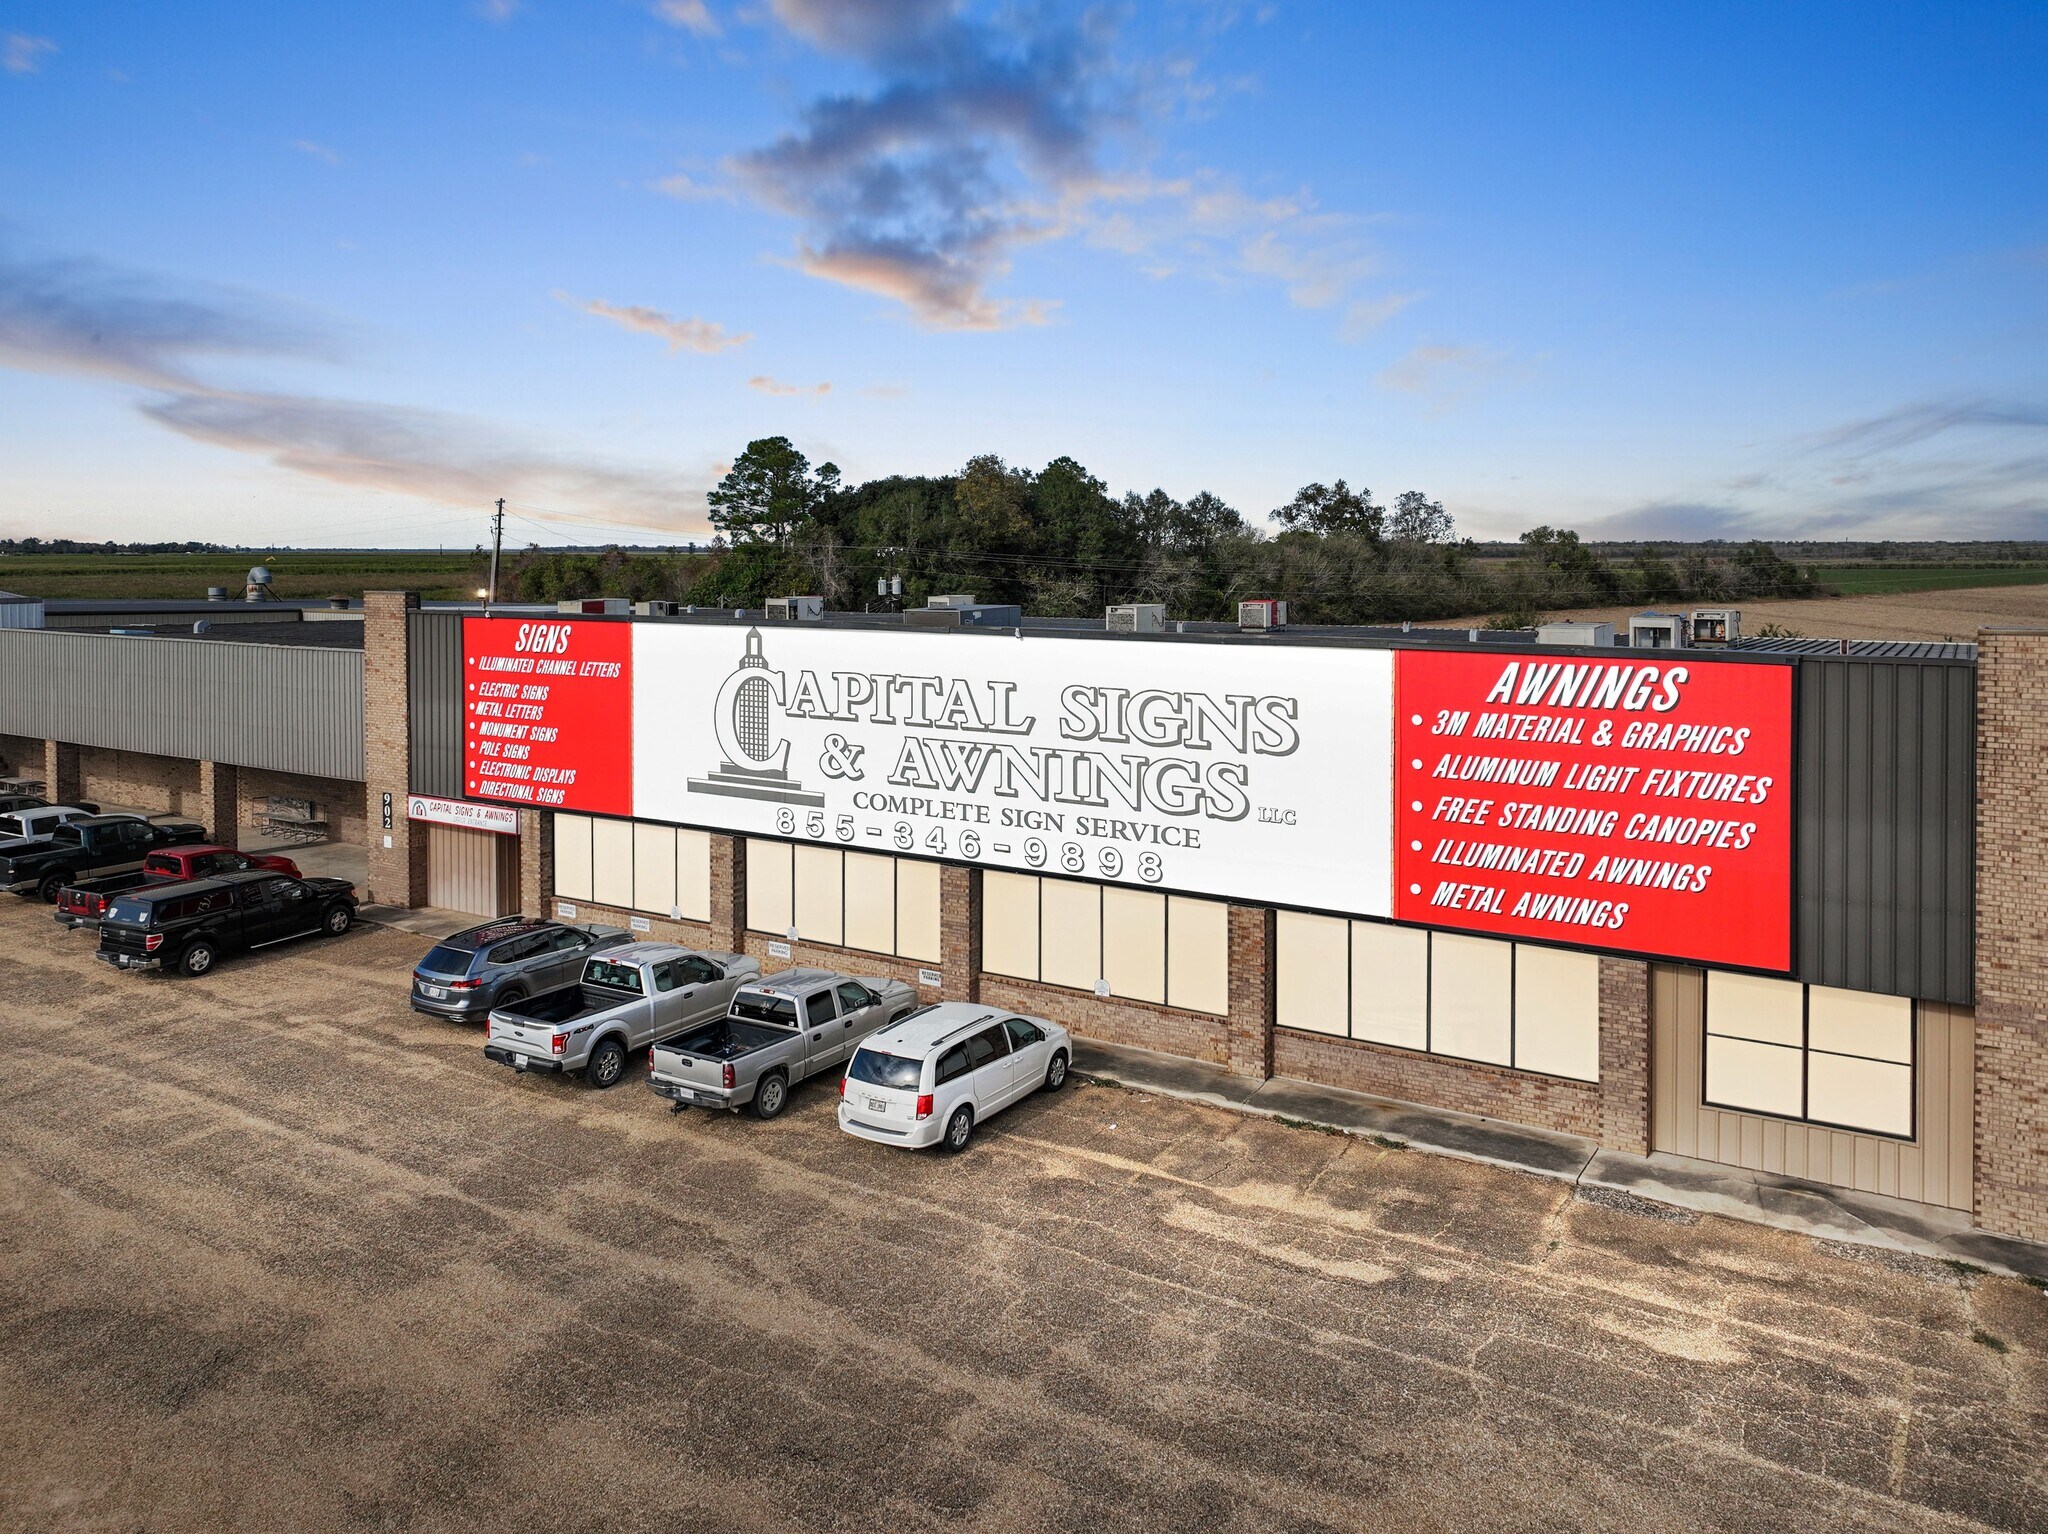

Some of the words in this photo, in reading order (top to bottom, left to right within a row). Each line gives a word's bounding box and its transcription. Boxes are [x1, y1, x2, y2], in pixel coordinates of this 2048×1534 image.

[515, 624, 571, 654] SIGNS
[479, 656, 534, 673] ILLUMINATED
[536, 660, 577, 676] CHANNEL
[579, 661, 621, 678] LETTERS
[1486, 662, 1690, 713] AWNINGS
[475, 701, 502, 717] METAL
[505, 704, 544, 721] LETTERS
[479, 682, 520, 699] ELECTRIC
[521, 685, 550, 701] SIGNS
[479, 721, 529, 740] MONUMENT
[530, 726, 558, 743] SIGNS
[714, 666, 1036, 772] CAPITAL
[1059, 685, 1300, 756] SIGNS
[1431, 710, 1469, 737] 3M
[1472, 713, 1583, 745] MATERIAL
[1591, 720, 1614, 747] &
[1621, 721, 1750, 756] GRAPHICS
[479, 741, 501, 757] POLE
[502, 743, 530, 760] SIGNS
[479, 760, 532, 780] ELECTRONIC
[533, 767, 576, 785] DISPLAYS
[479, 780, 534, 801] DIRECTIONAL
[536, 787, 565, 805] SIGNS
[819, 733, 865, 781] &
[888, 736, 1250, 822] AWNINGS
[1258, 807, 1296, 825] LLC
[1432, 754, 1560, 787] ALUMINUM
[1564, 763, 1640, 794] LIGHT
[1640, 769, 1773, 805] FIXTURES
[430, 802, 452, 815] CAPITAL
[455, 806, 473, 818] SIGNS
[477, 809, 482, 818] &
[485, 810, 513, 823] AWNINGS
[853, 791, 990, 824] COMPLETE
[1001, 807, 1065, 833] SIGN
[1076, 816, 1201, 849] SERVICE
[1432, 796, 1494, 826] FREE
[1498, 804, 1618, 838] STANDING
[1624, 813, 1756, 850] CANOPIES
[776, 807, 1163, 883] 855-346-9898
[1431, 839, 1586, 879] ILLUMINATED
[1588, 857, 1712, 893] AWNINGS
[1431, 881, 1506, 915] METAL
[1512, 892, 1629, 930] AWNINGS
